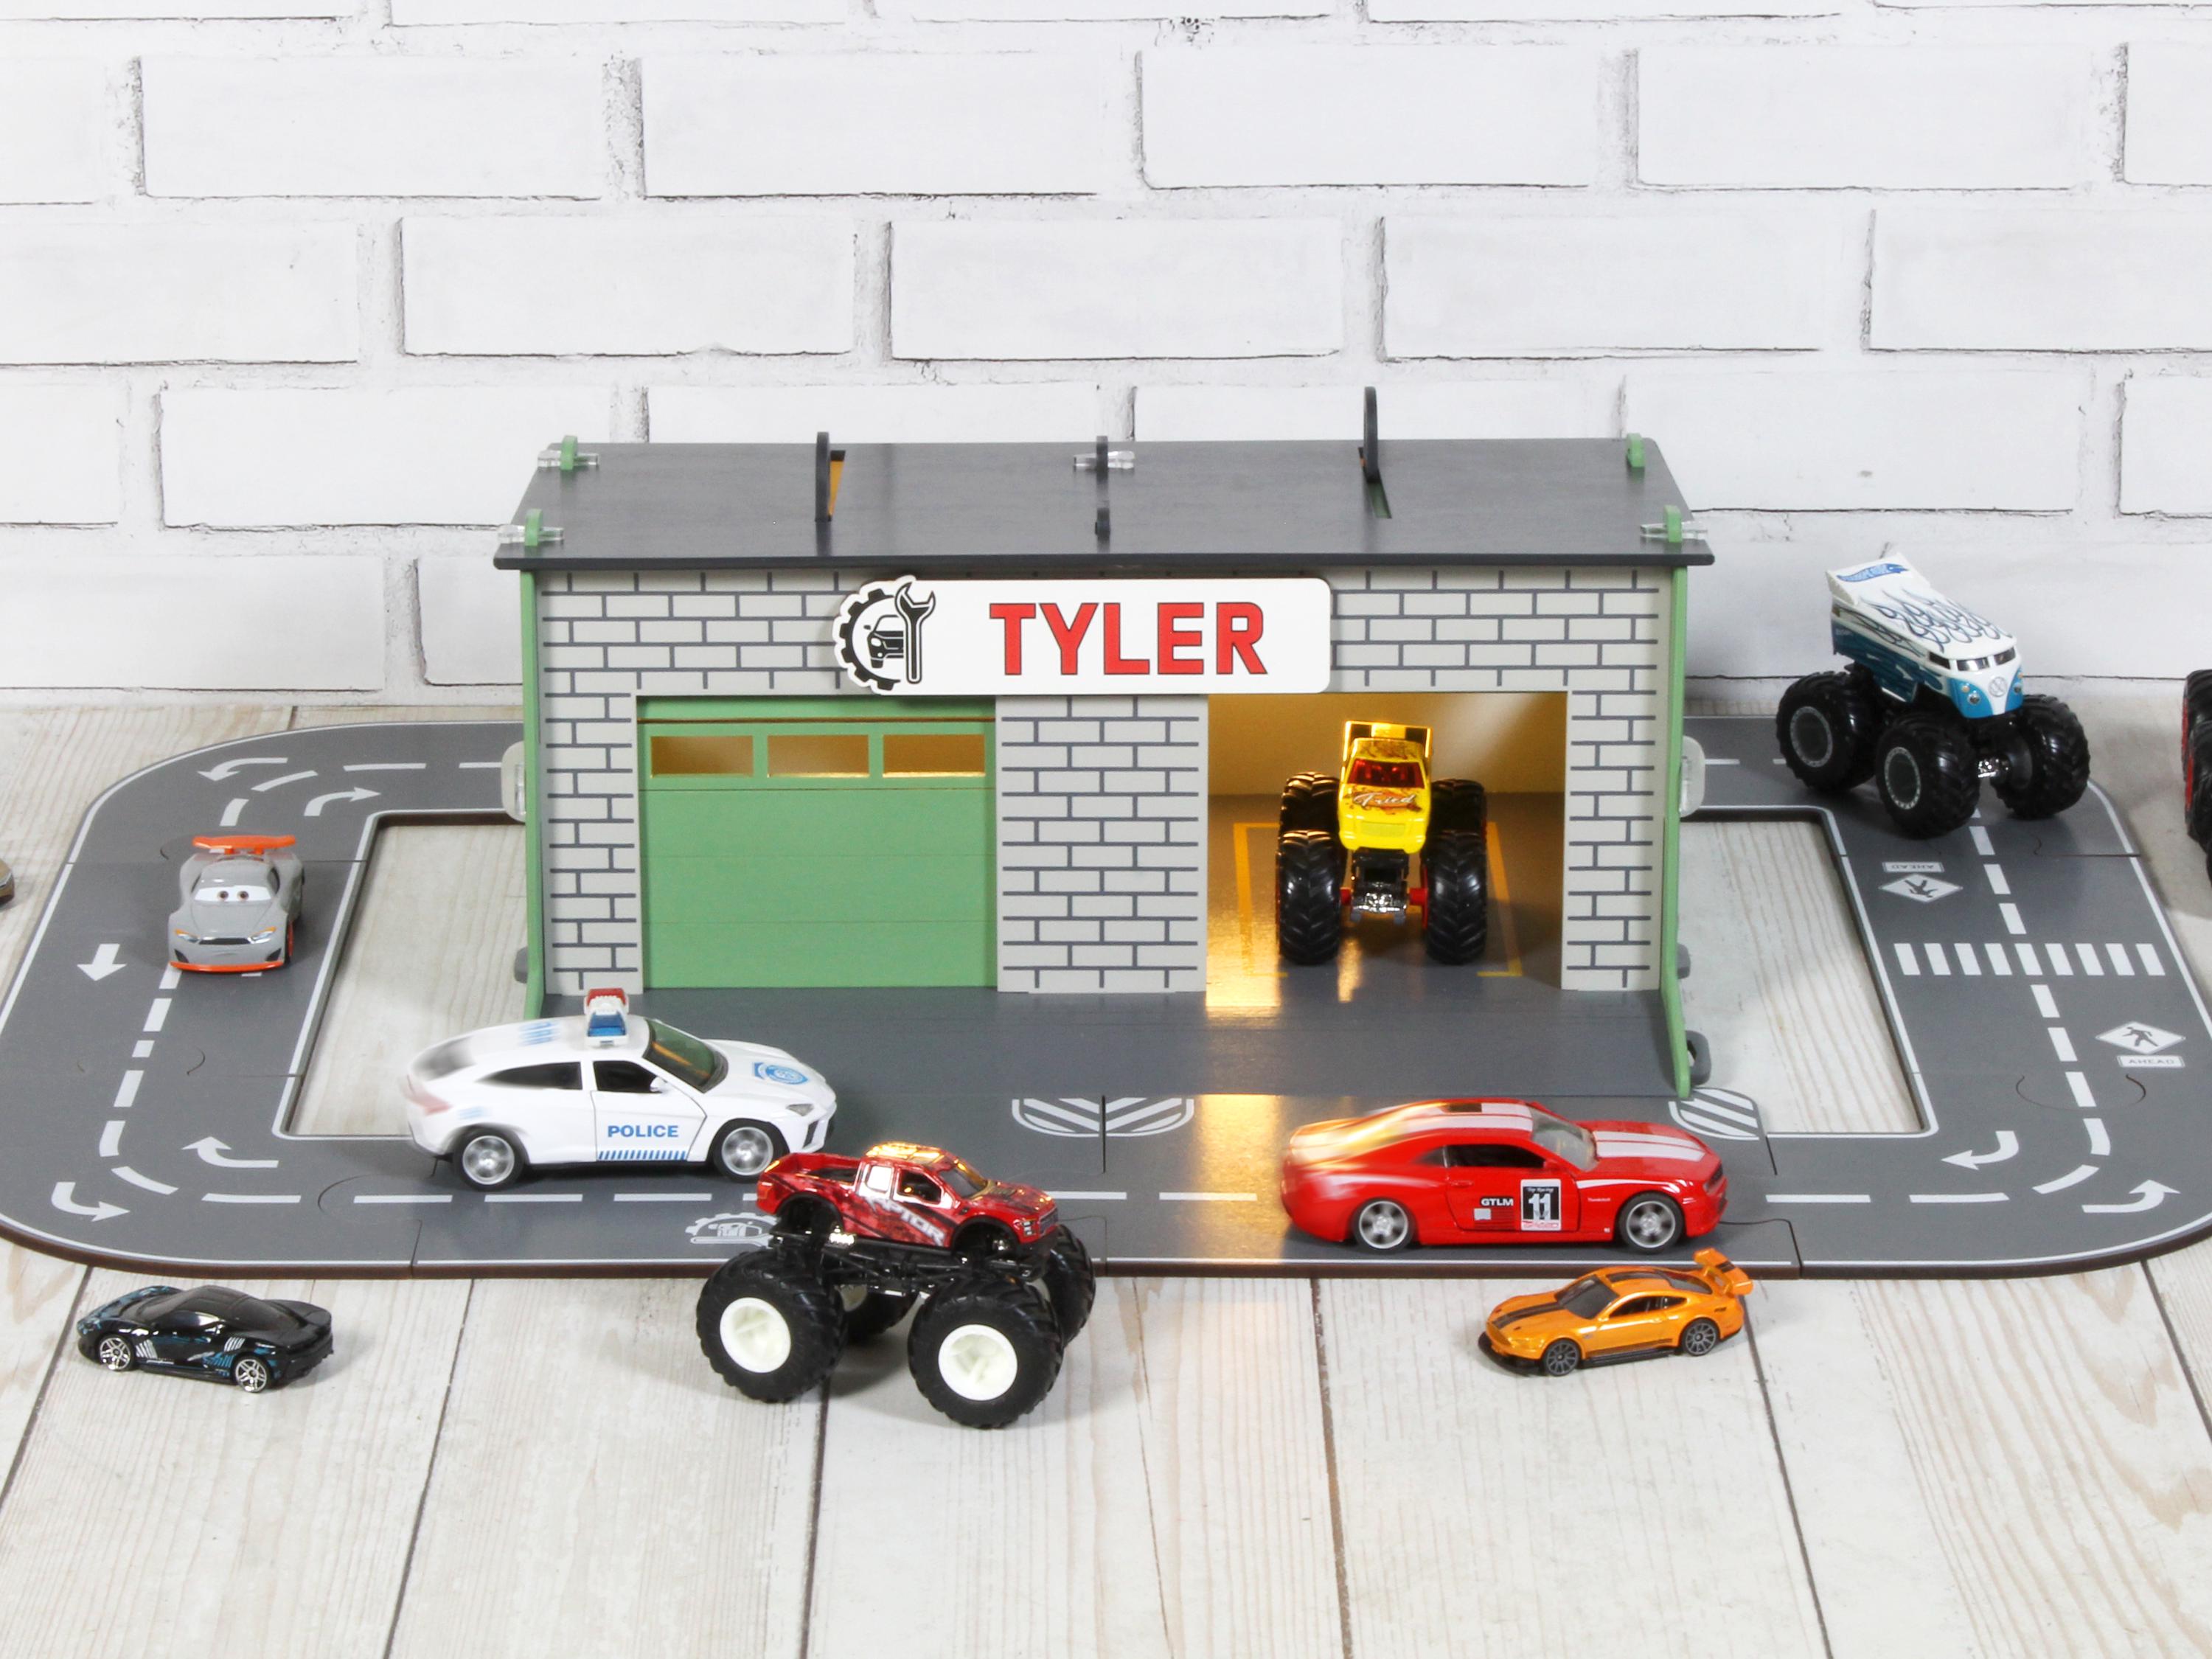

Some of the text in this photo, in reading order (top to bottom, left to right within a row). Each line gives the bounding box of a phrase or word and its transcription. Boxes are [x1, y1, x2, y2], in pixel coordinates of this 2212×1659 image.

[990, 602, 1268, 675] TYLER
[608, 1124, 679, 1138] POLICE
[1481, 1197, 1514, 1207] GTLM
[1528, 1193, 1551, 1222] 11
